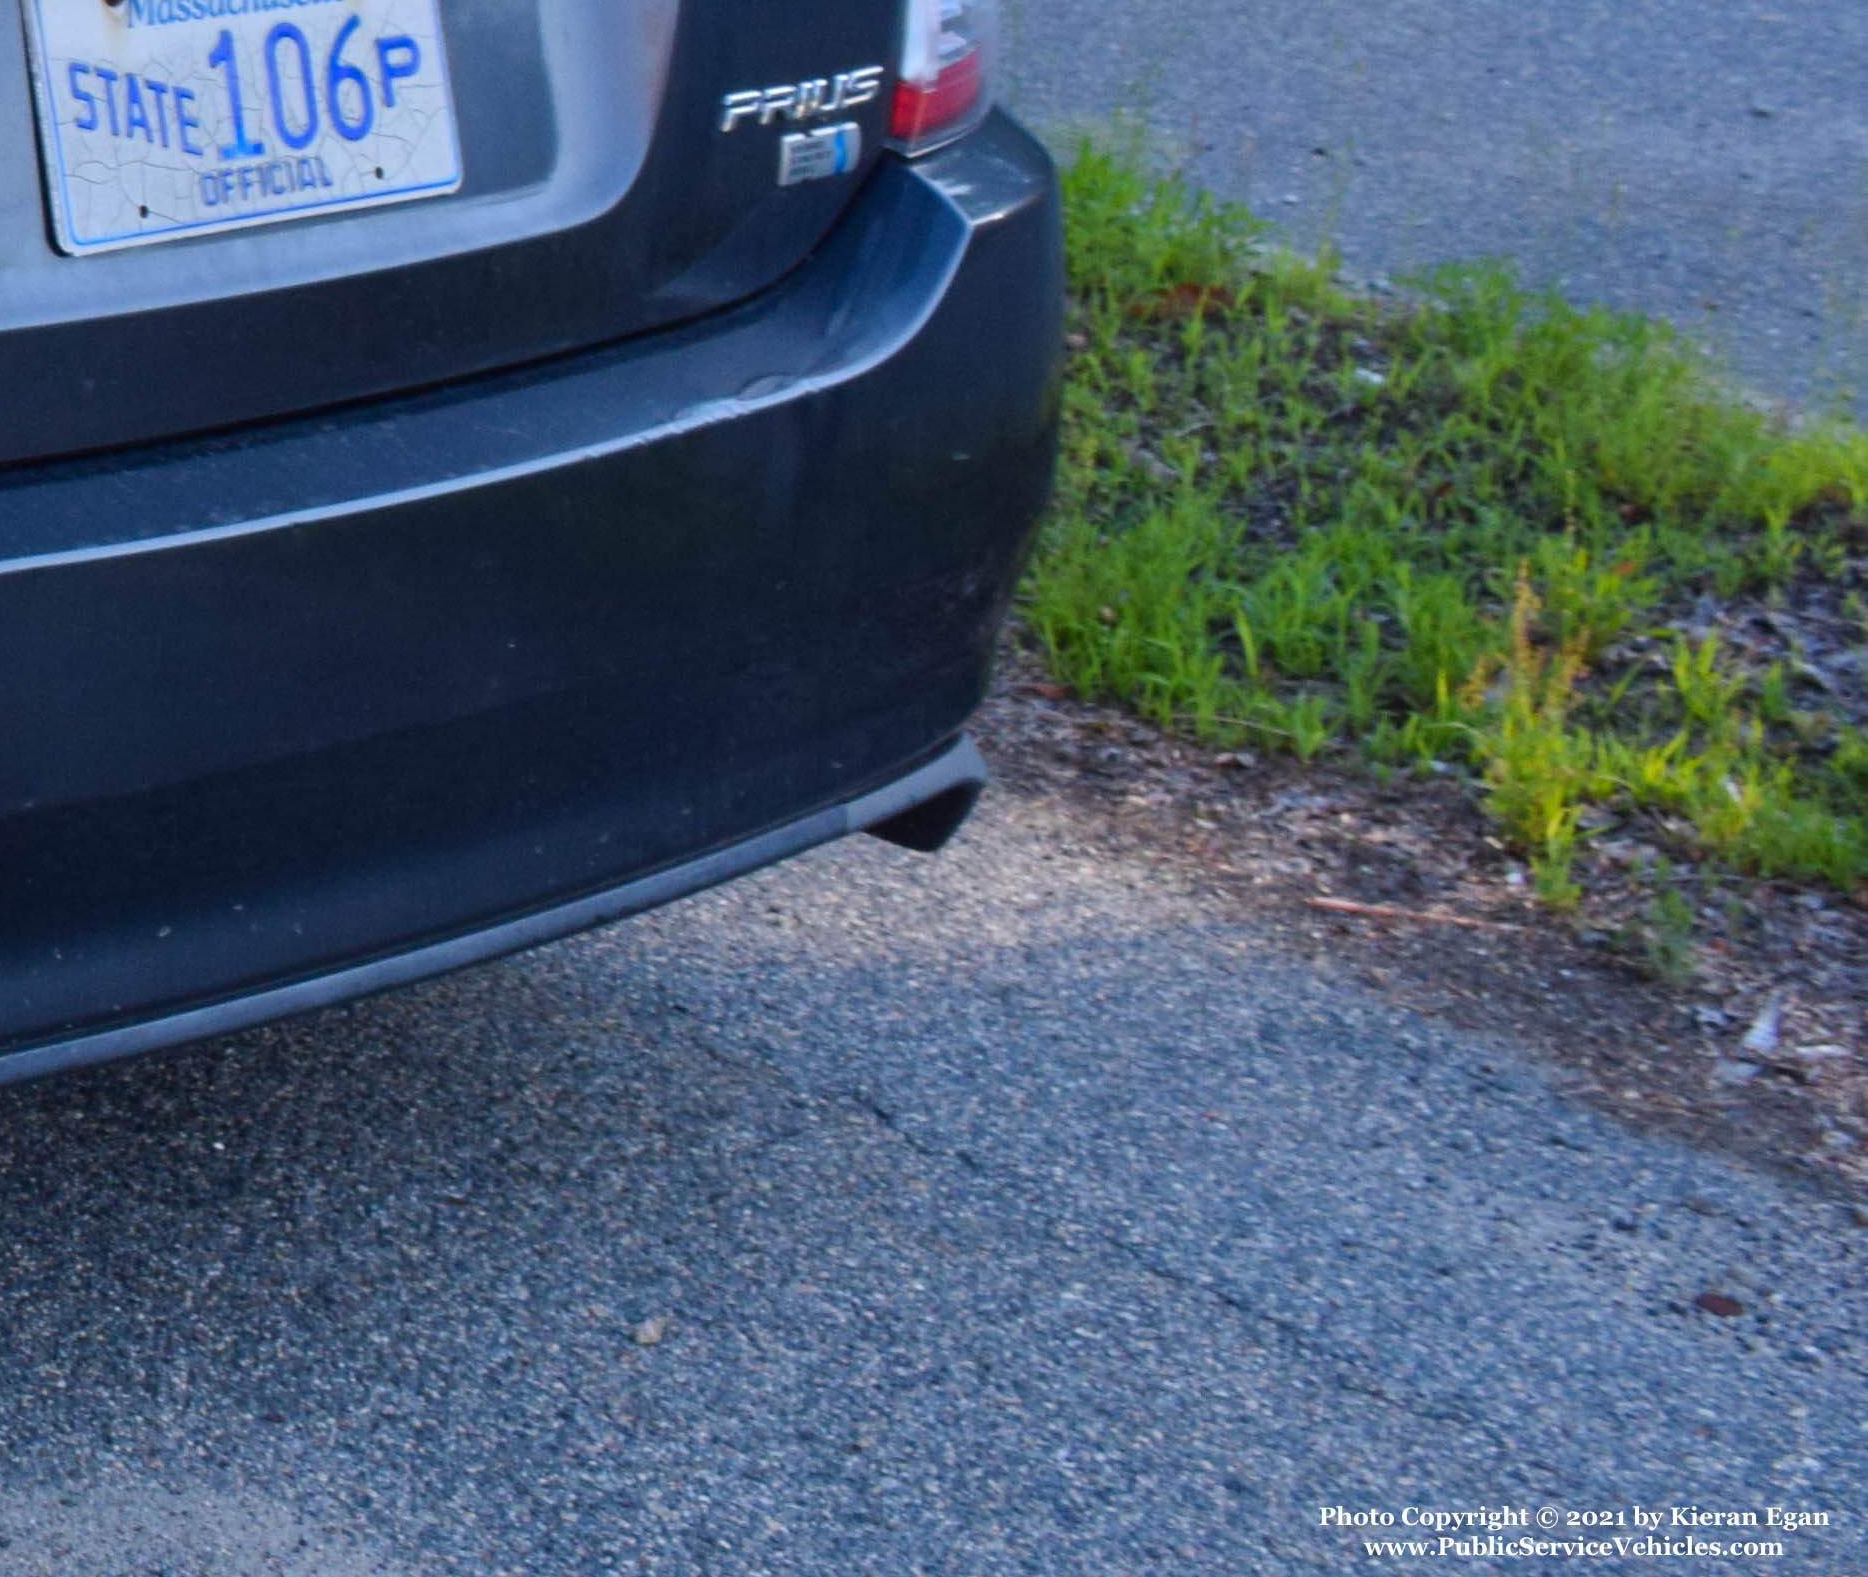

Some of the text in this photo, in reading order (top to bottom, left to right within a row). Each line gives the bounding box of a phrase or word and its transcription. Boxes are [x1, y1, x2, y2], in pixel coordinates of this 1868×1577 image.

[67, 61, 204, 157] STATE
[720, 65, 884, 133] PRIUS
[200, 156, 334, 207] OFFICIAL
